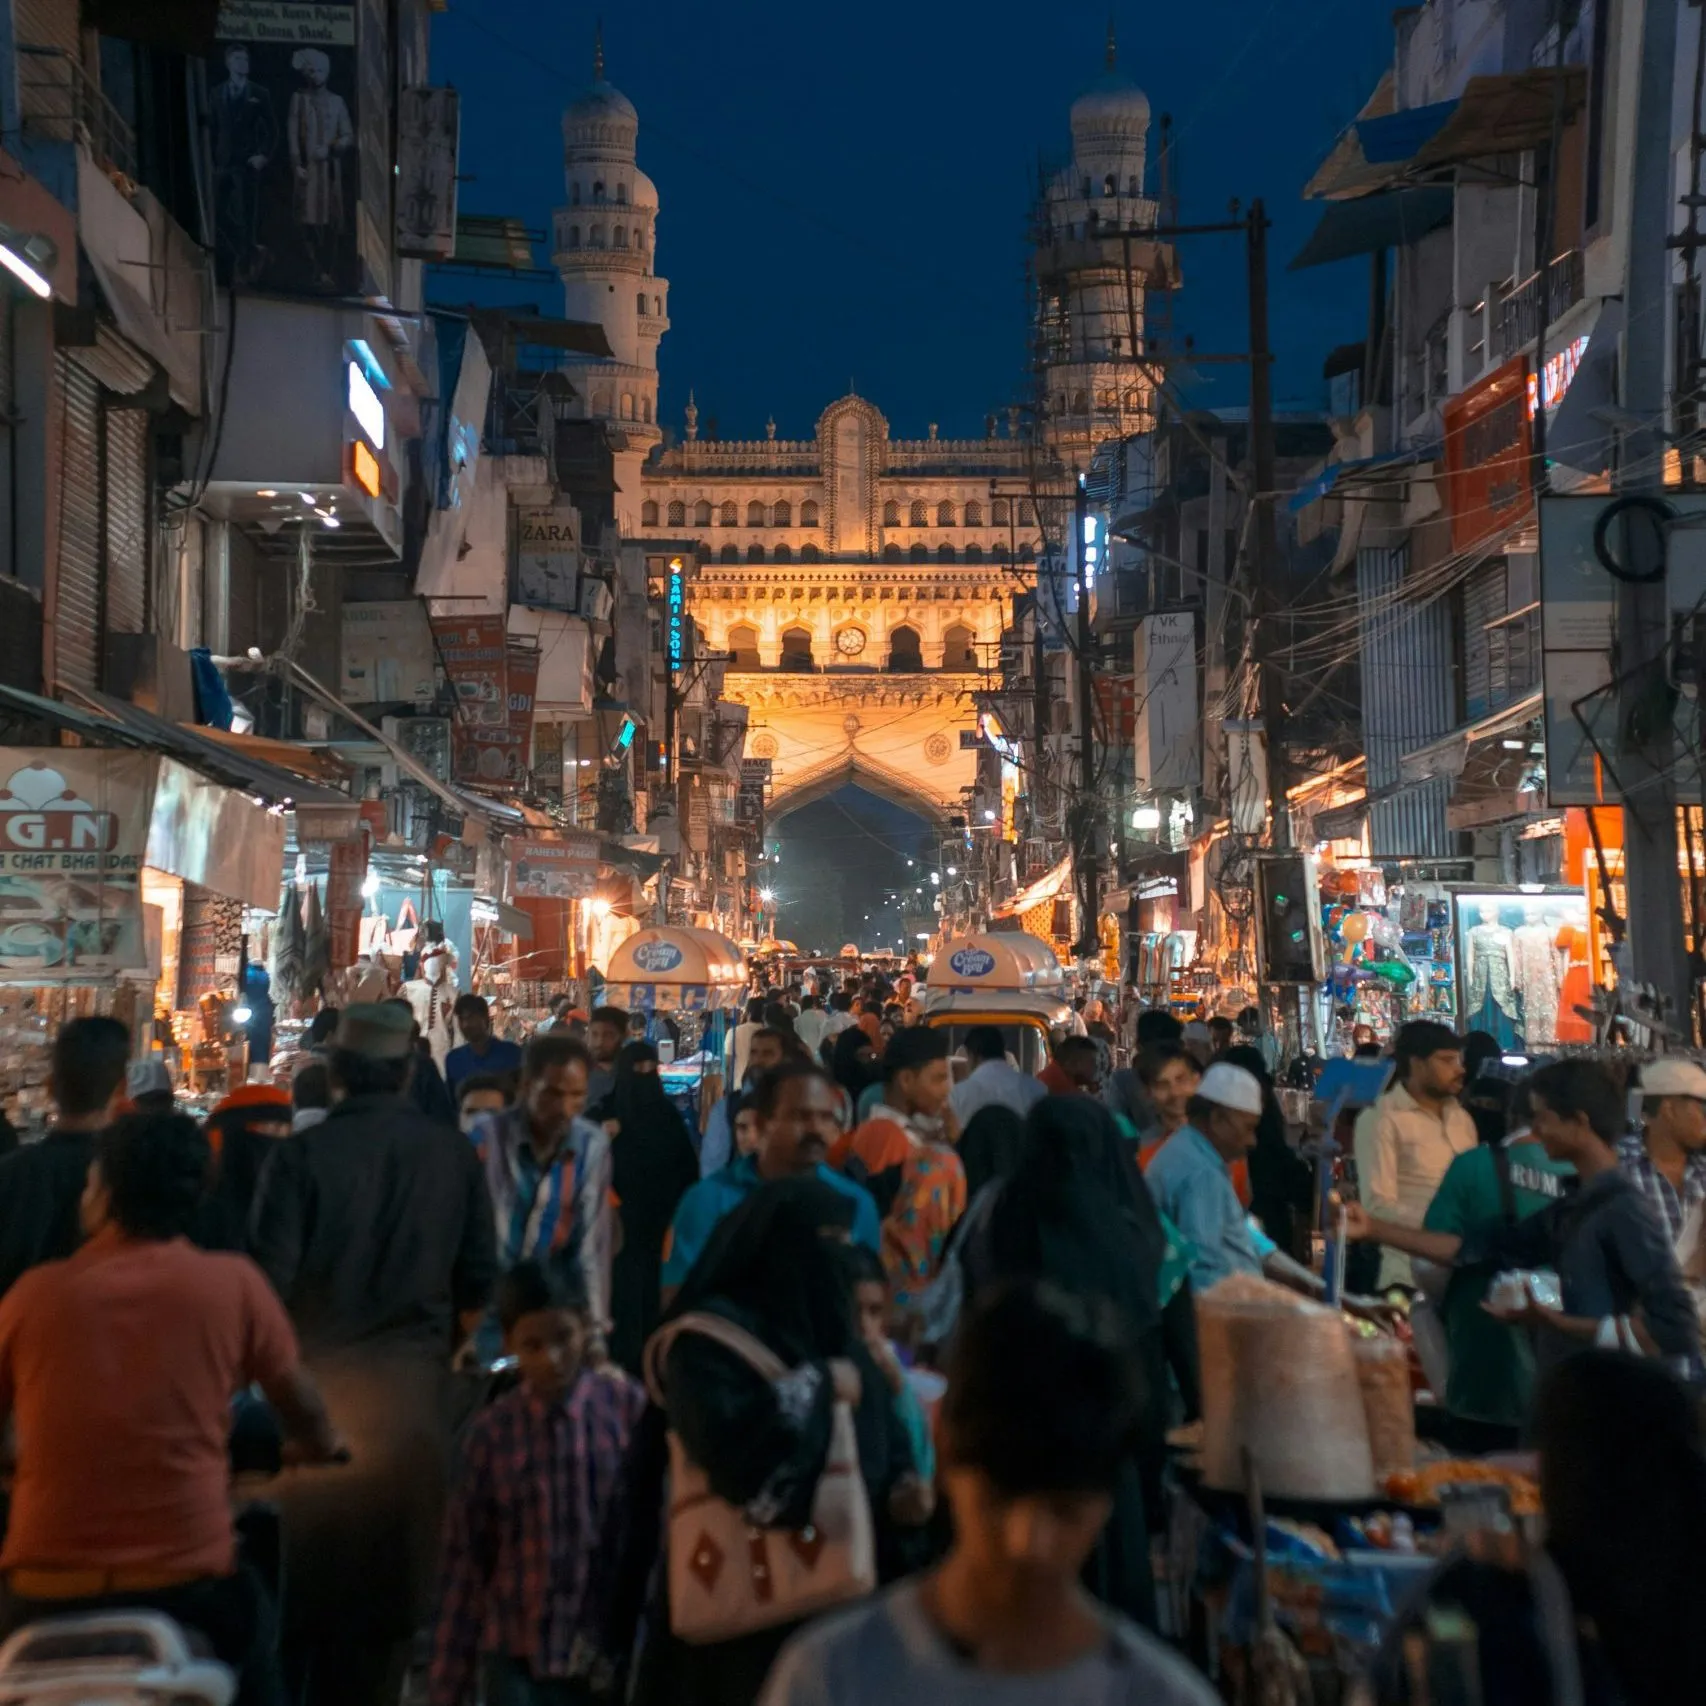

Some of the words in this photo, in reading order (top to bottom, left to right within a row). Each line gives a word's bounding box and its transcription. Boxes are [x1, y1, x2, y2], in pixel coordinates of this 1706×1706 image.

[523, 525, 574, 541] ZARA
[670, 575, 681, 613] SAMI
[1159, 616, 1178, 627] VK
[507, 694, 532, 712] GDI
[12, 854, 56, 869] CHAT
[1509, 1162, 1566, 1197] RUM
